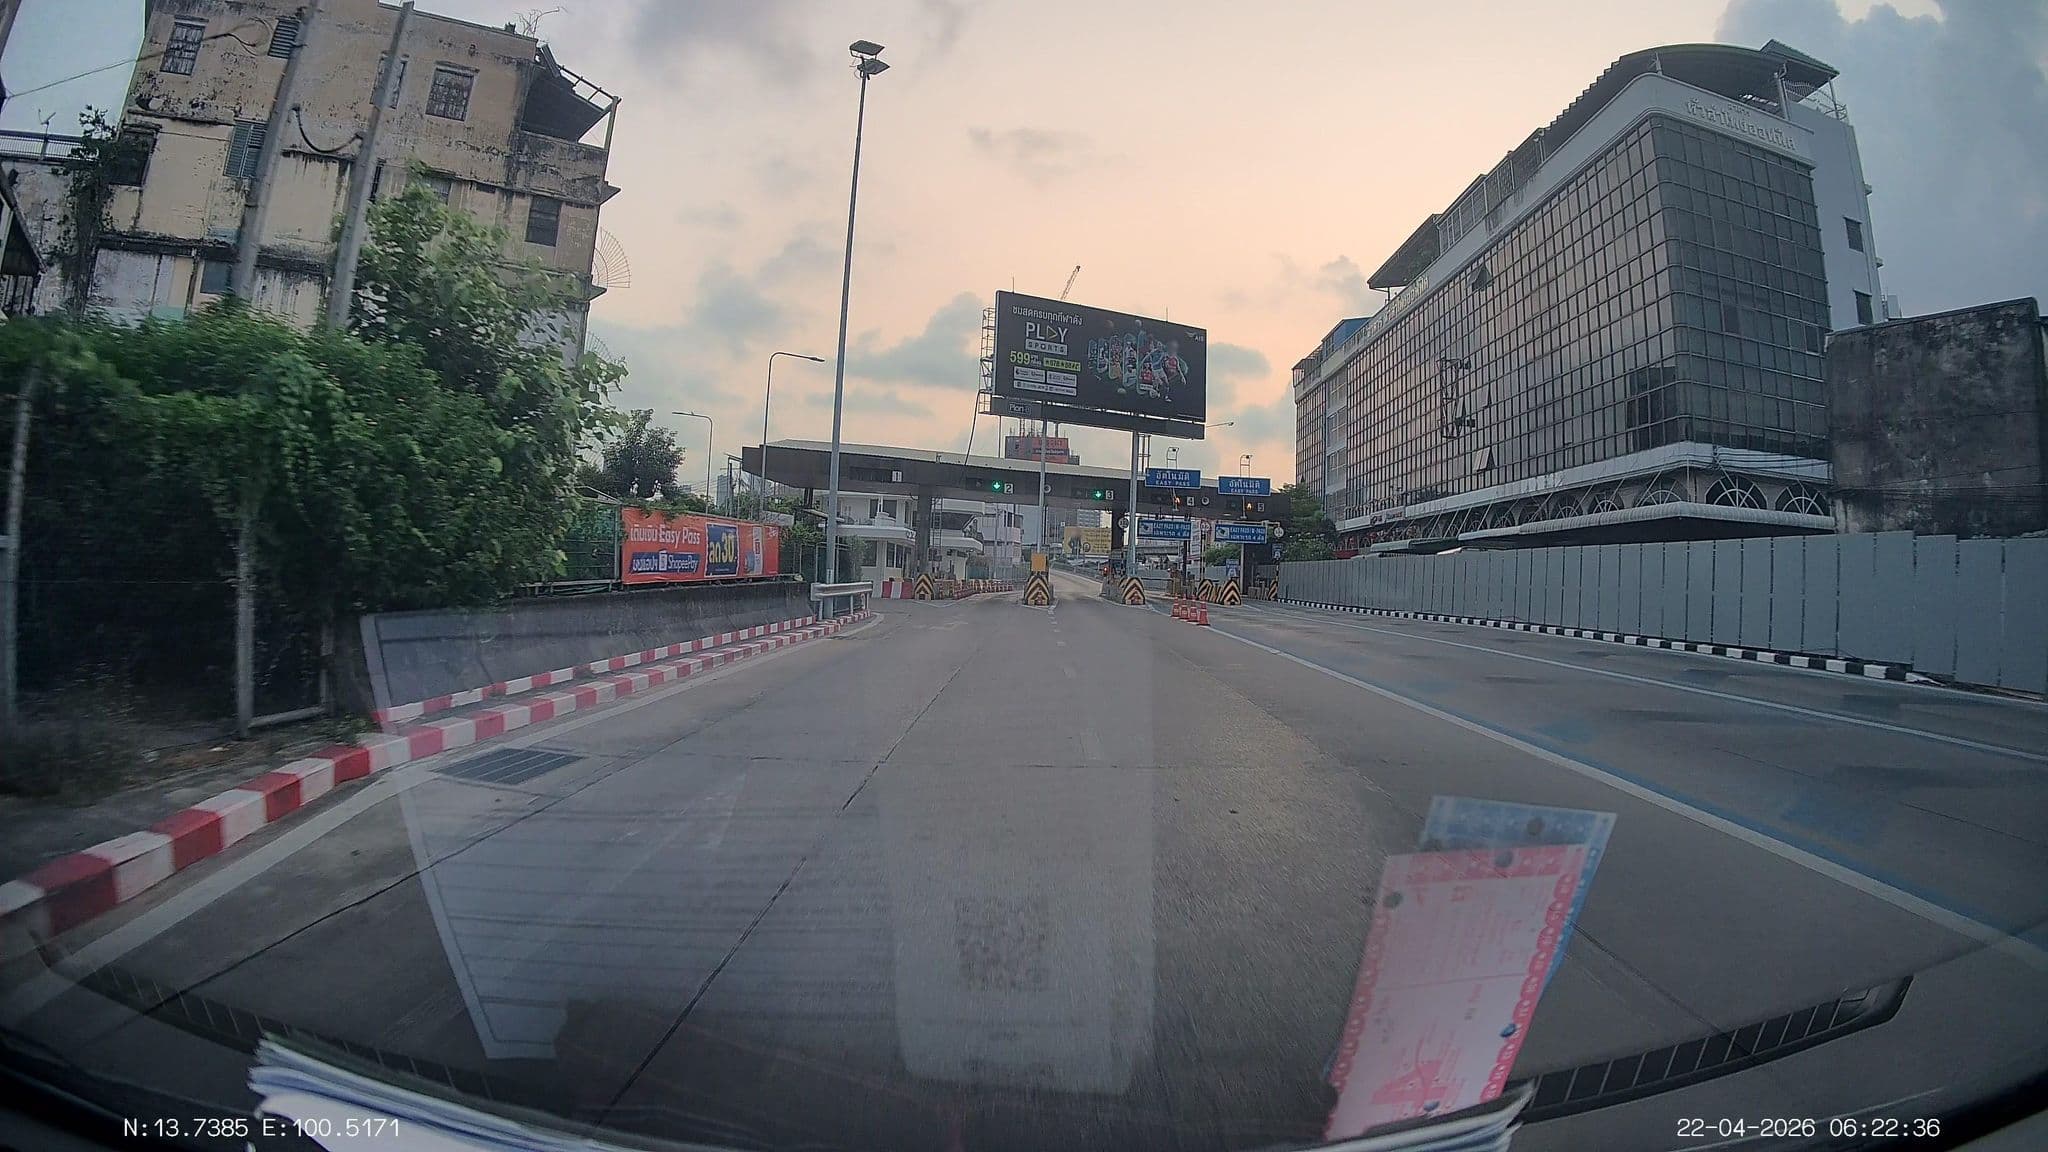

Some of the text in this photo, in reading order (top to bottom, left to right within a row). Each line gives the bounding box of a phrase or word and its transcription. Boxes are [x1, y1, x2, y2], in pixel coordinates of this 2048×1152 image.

[1028, 341, 1065, 353] SPORTS
[1009, 350, 1030, 365] 599
[630, 524, 700, 549] เติมเงิน Easy Pass
[709, 541, 721, 563] ลด
[668, 554, 698, 573] ShopeePay
